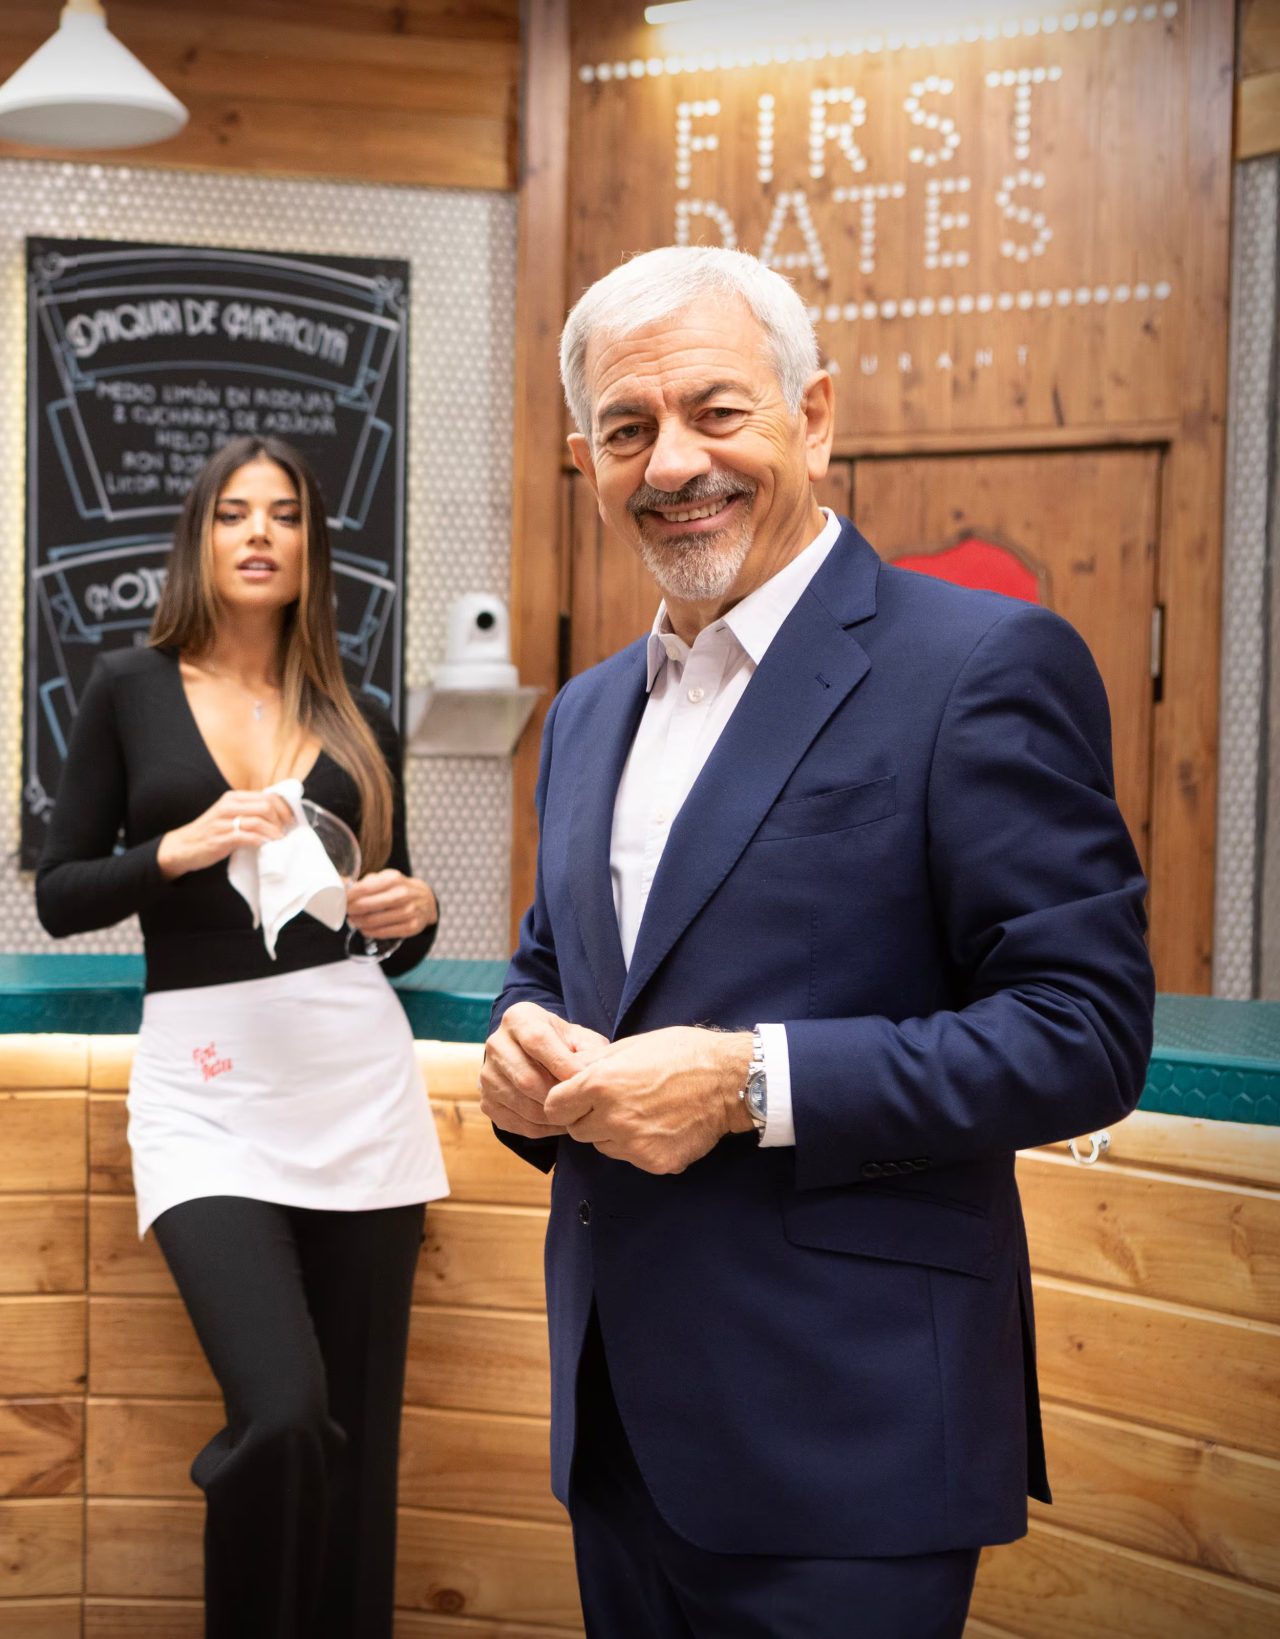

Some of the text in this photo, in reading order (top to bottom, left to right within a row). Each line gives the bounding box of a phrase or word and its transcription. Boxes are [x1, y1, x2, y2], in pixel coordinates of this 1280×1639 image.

[675, 65, 1063, 190] FIRST
[675, 168, 1053, 280] DATES
[183, 298, 219, 336] DE
[96, 382, 156, 404] MEDIO
[225, 385, 251, 408] EN
[233, 409, 257, 431] DE
